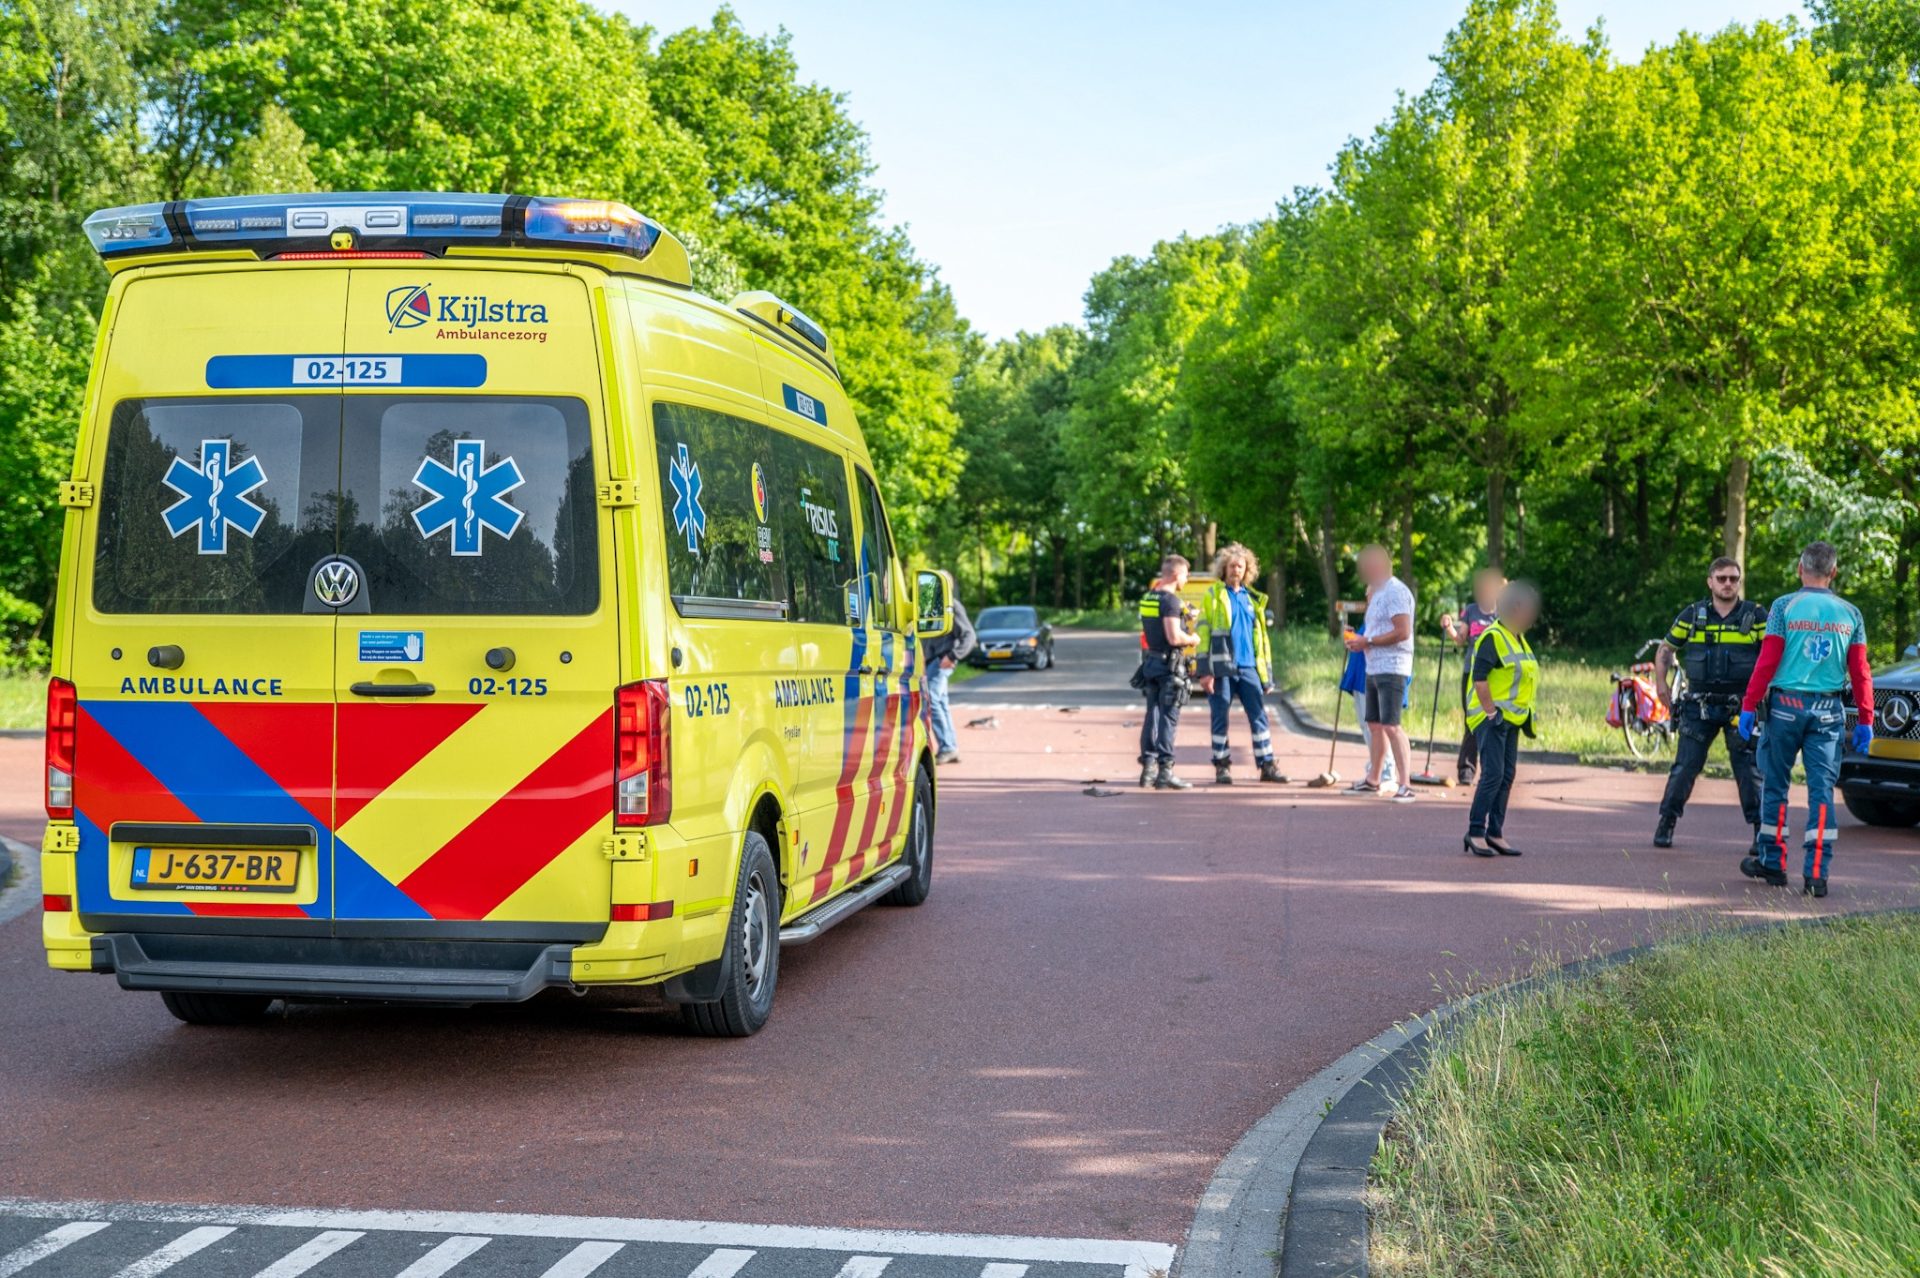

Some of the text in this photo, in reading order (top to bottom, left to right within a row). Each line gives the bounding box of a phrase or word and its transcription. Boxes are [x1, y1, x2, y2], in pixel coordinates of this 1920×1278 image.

[437, 296, 549, 328] Kijlstra
[436, 328, 548, 343] Ambulancezorg
[307, 361, 387, 380] 02-125
[1787, 620, 1852, 636] AMBULANCE
[120, 677, 283, 696] AMBULANCE
[468, 677, 548, 696] 02-125
[775, 677, 835, 708] AMBULANCE
[685, 683, 730, 718] 02-125
[136, 869, 146, 878] NL
[159, 853, 282, 881] J-637-BR
